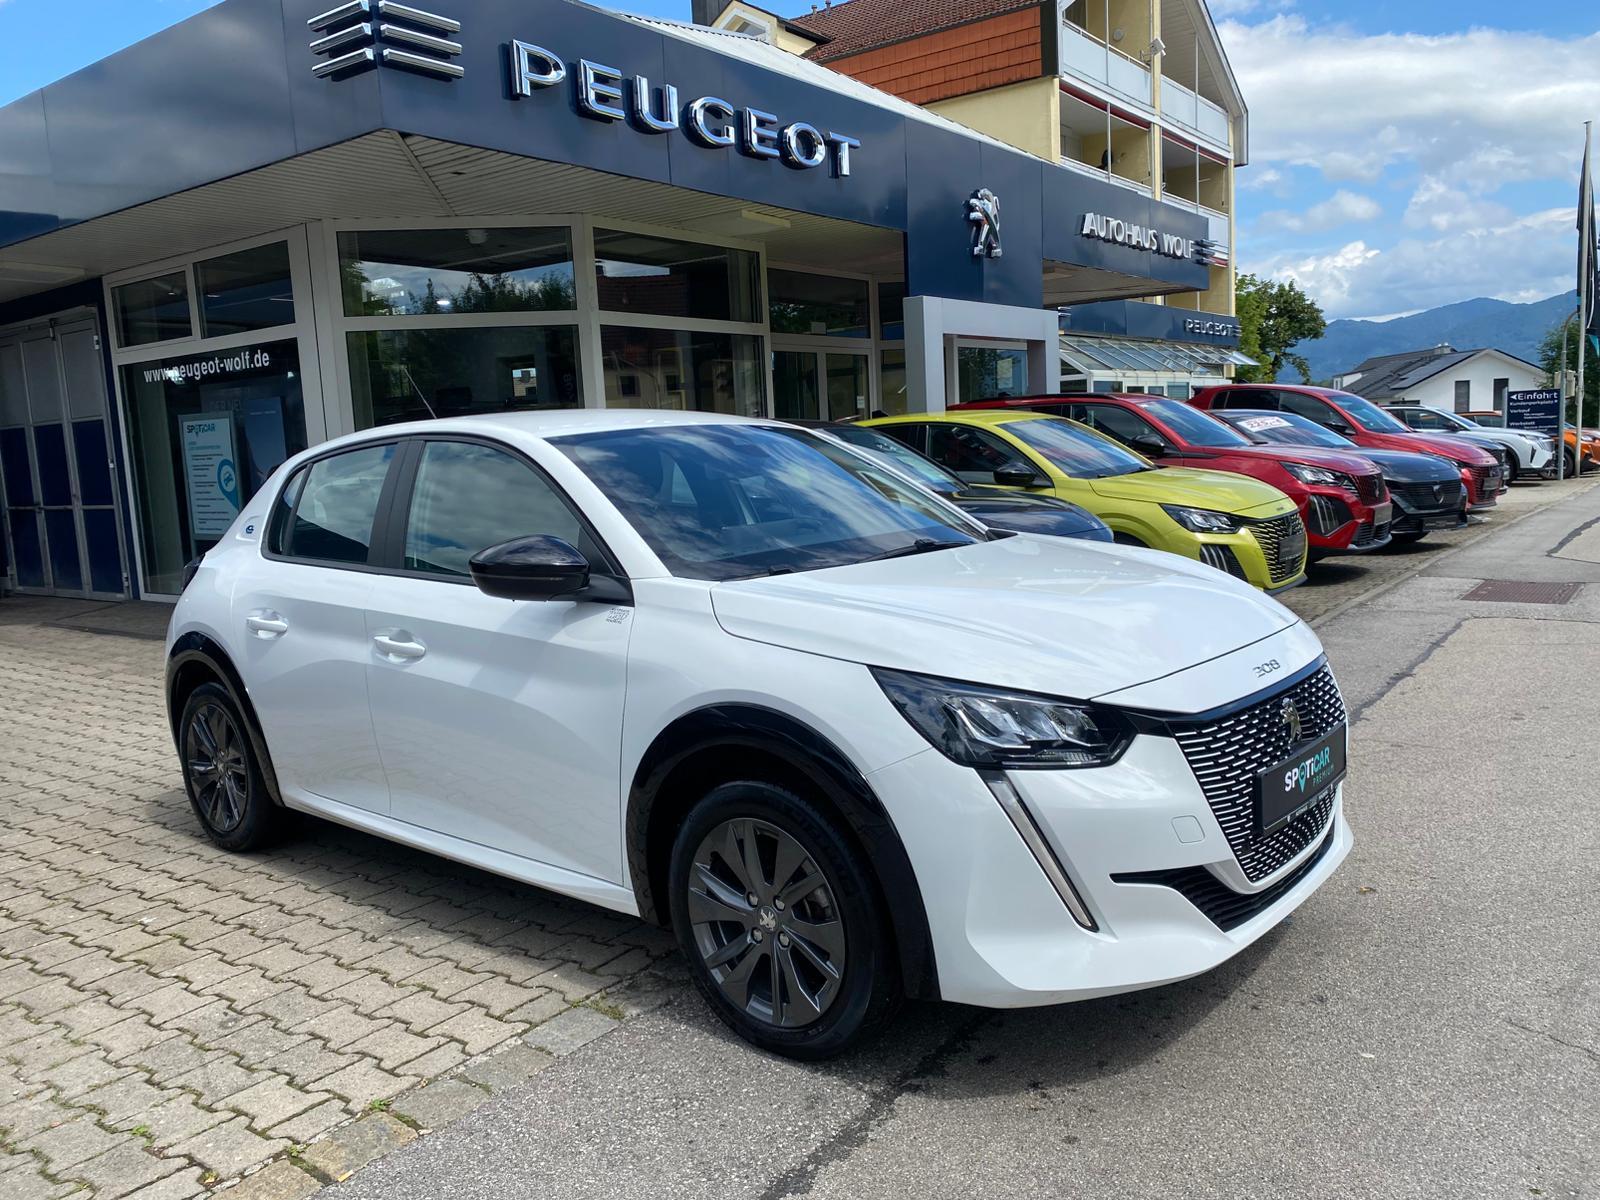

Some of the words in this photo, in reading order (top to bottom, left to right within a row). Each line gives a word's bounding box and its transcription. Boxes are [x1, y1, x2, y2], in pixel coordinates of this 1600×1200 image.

[510, 38, 862, 178] PEUGEOT
[1082, 212, 1158, 251] AUTOHAUS
[1162, 232, 1195, 259] WOLF
[1186, 318, 1233, 337] PEUGEOT
[143, 349, 270, 383] wwwpeugeot-wolf.de
[1517, 391, 1558, 401] Einfahrt
[1252, 659, 1281, 678] 208
